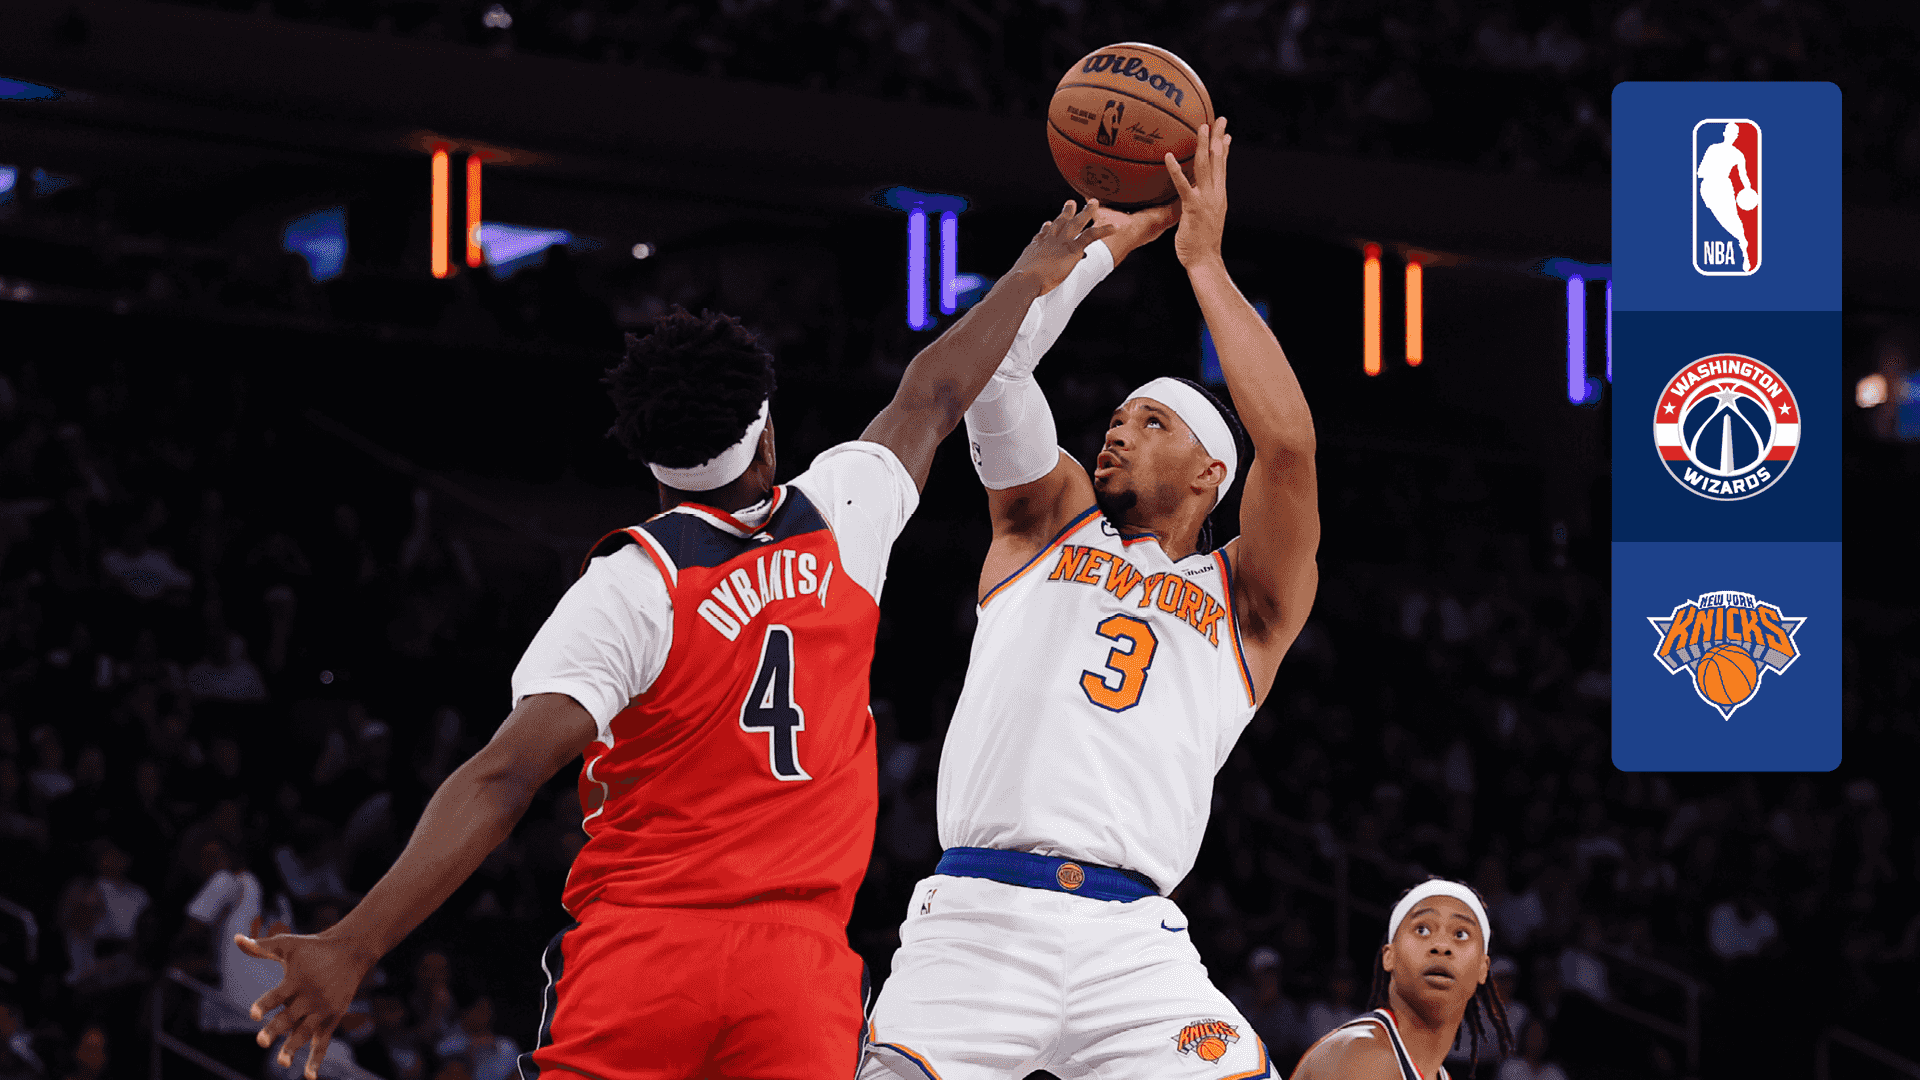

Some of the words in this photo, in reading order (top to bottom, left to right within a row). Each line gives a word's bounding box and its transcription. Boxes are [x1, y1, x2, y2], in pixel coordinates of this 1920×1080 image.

[1082, 54, 1184, 107] Wilson
[1047, 544, 1143, 601] NEW
[1137, 572, 1226, 649] YORK
[739, 624, 813, 781] 4
[1079, 613, 1159, 713] 3
[1177, 1020, 1241, 1052] KNICKS
